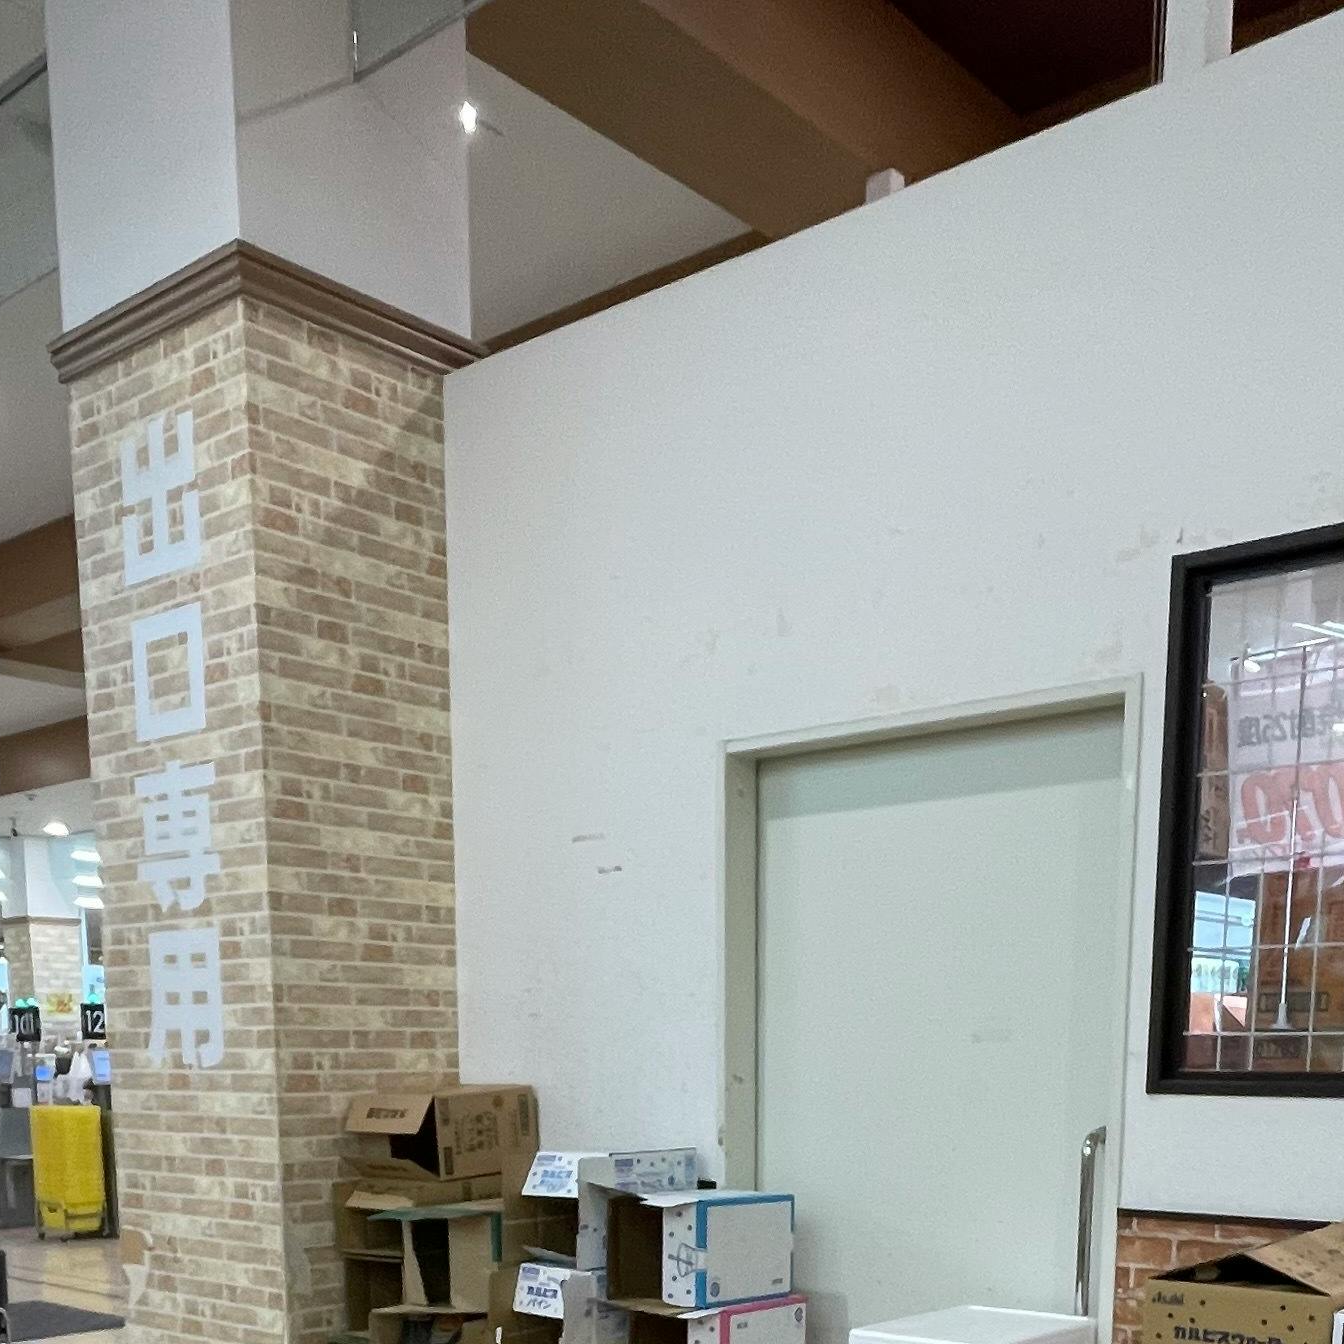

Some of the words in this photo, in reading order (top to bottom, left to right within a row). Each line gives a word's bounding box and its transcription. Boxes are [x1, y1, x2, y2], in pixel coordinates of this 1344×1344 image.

[120, 410, 224, 1068] 出口専用
[85, 1009, 105, 1034] 12
